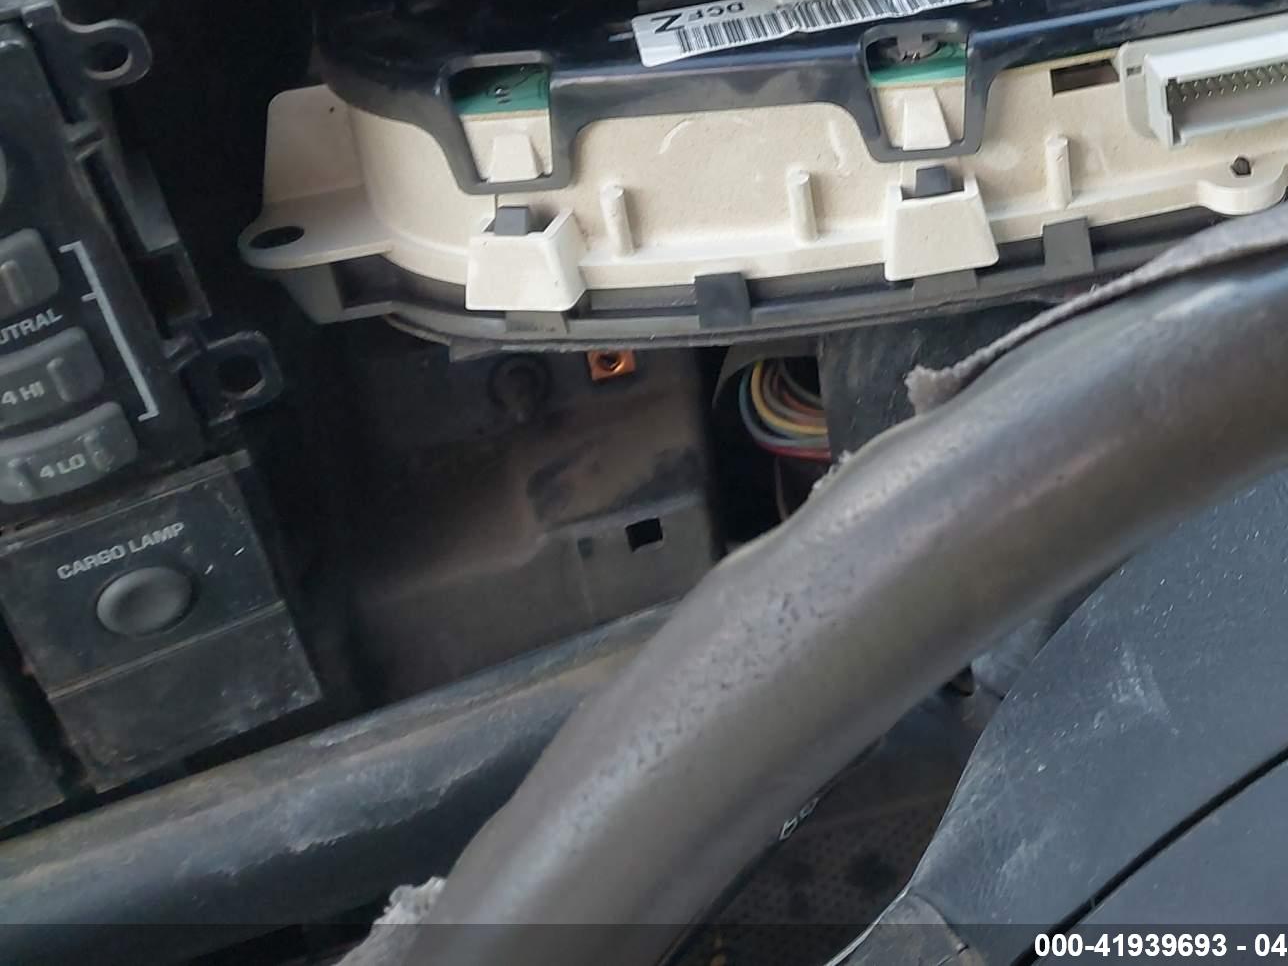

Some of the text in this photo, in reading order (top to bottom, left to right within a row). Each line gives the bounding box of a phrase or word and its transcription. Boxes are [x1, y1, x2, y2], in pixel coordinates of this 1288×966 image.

[1, 380, 46, 406] 4 HI
[39, 452, 87, 480] 4 LO
[57, 521, 185, 581] CARGO LAMP
